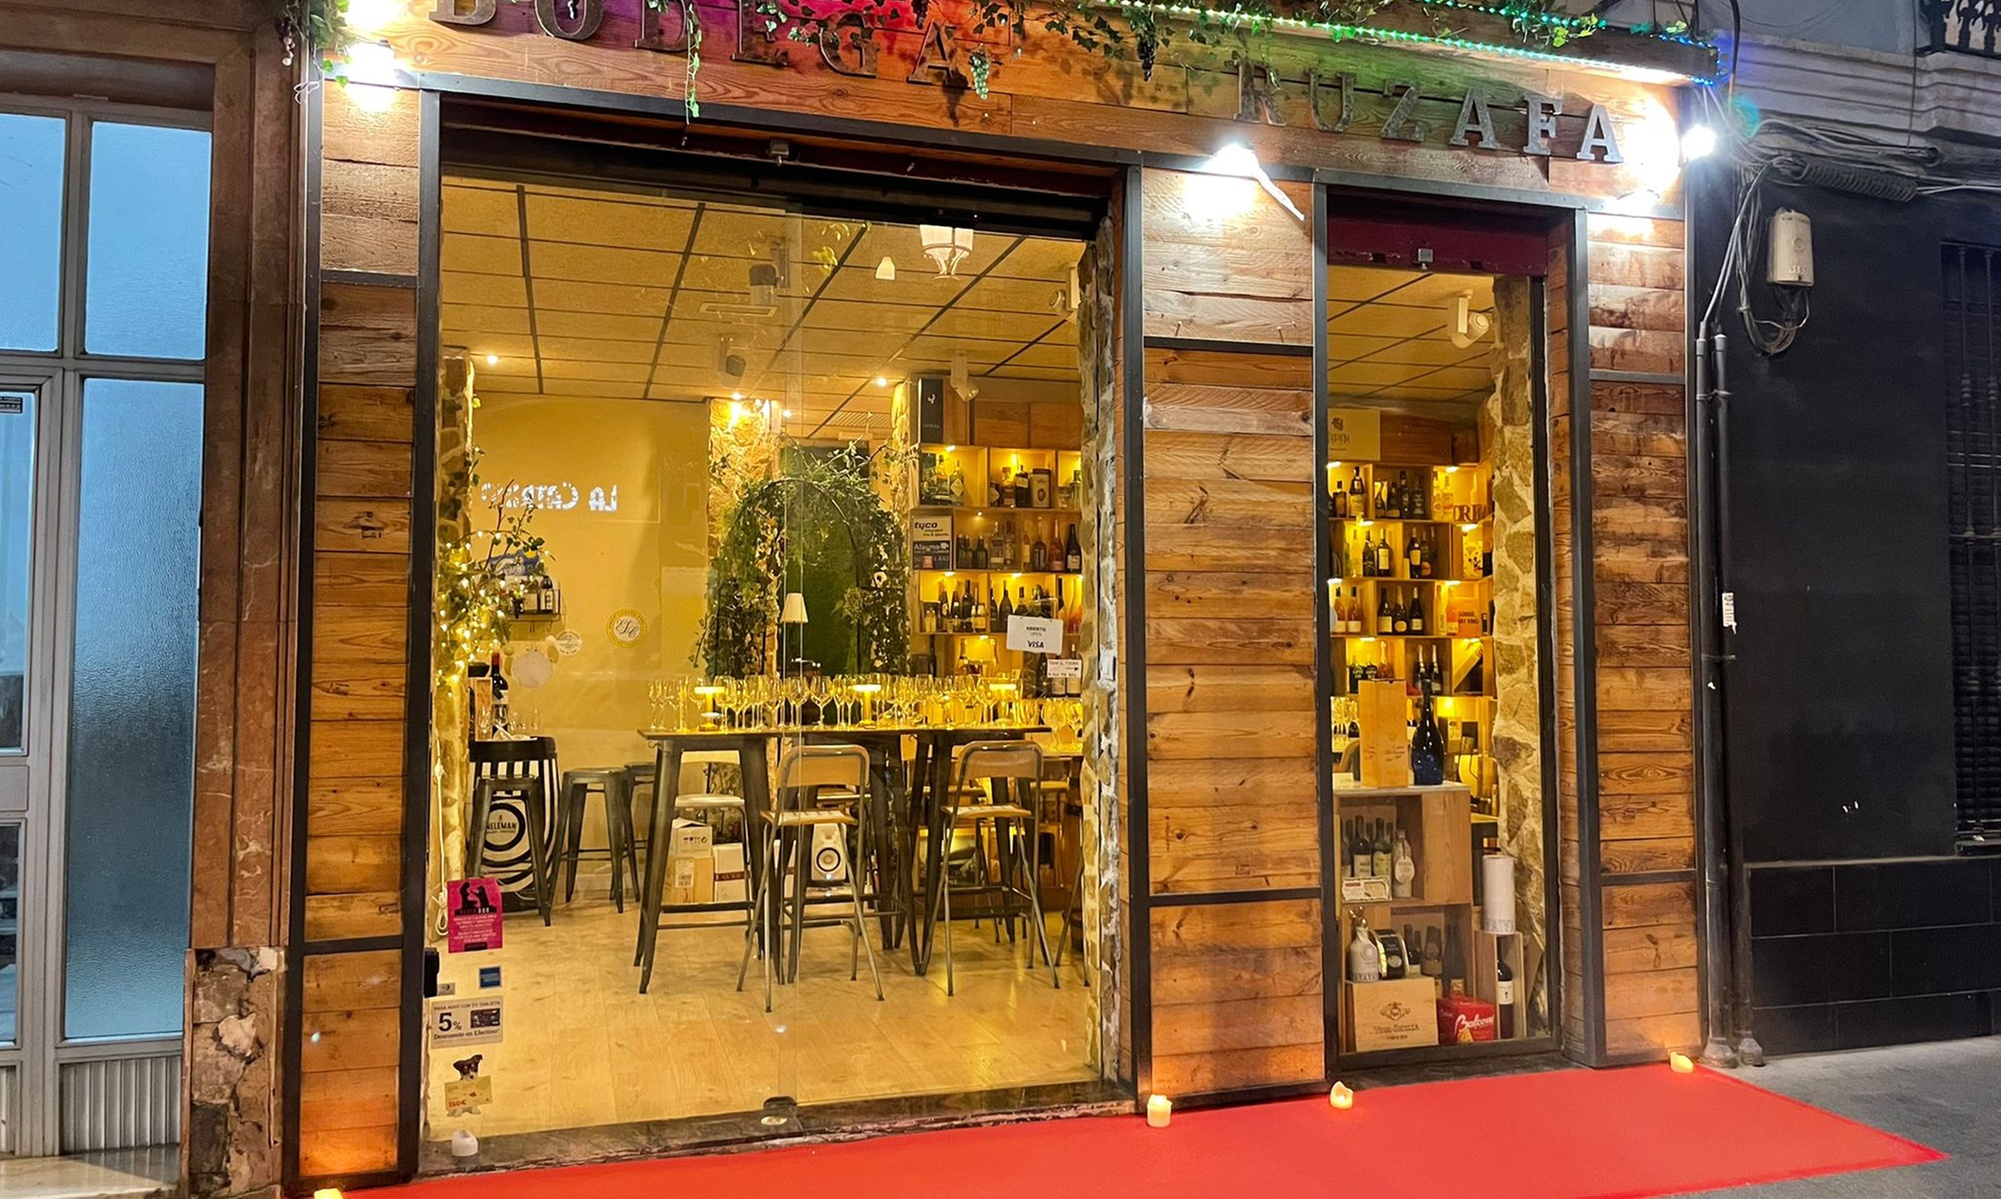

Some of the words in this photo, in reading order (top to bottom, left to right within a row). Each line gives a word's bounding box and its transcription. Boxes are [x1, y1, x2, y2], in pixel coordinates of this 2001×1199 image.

[1233, 59, 1624, 163] RUZAFA
[914, 520, 938, 531] tyco
[1027, 640, 1044, 648] VISA
